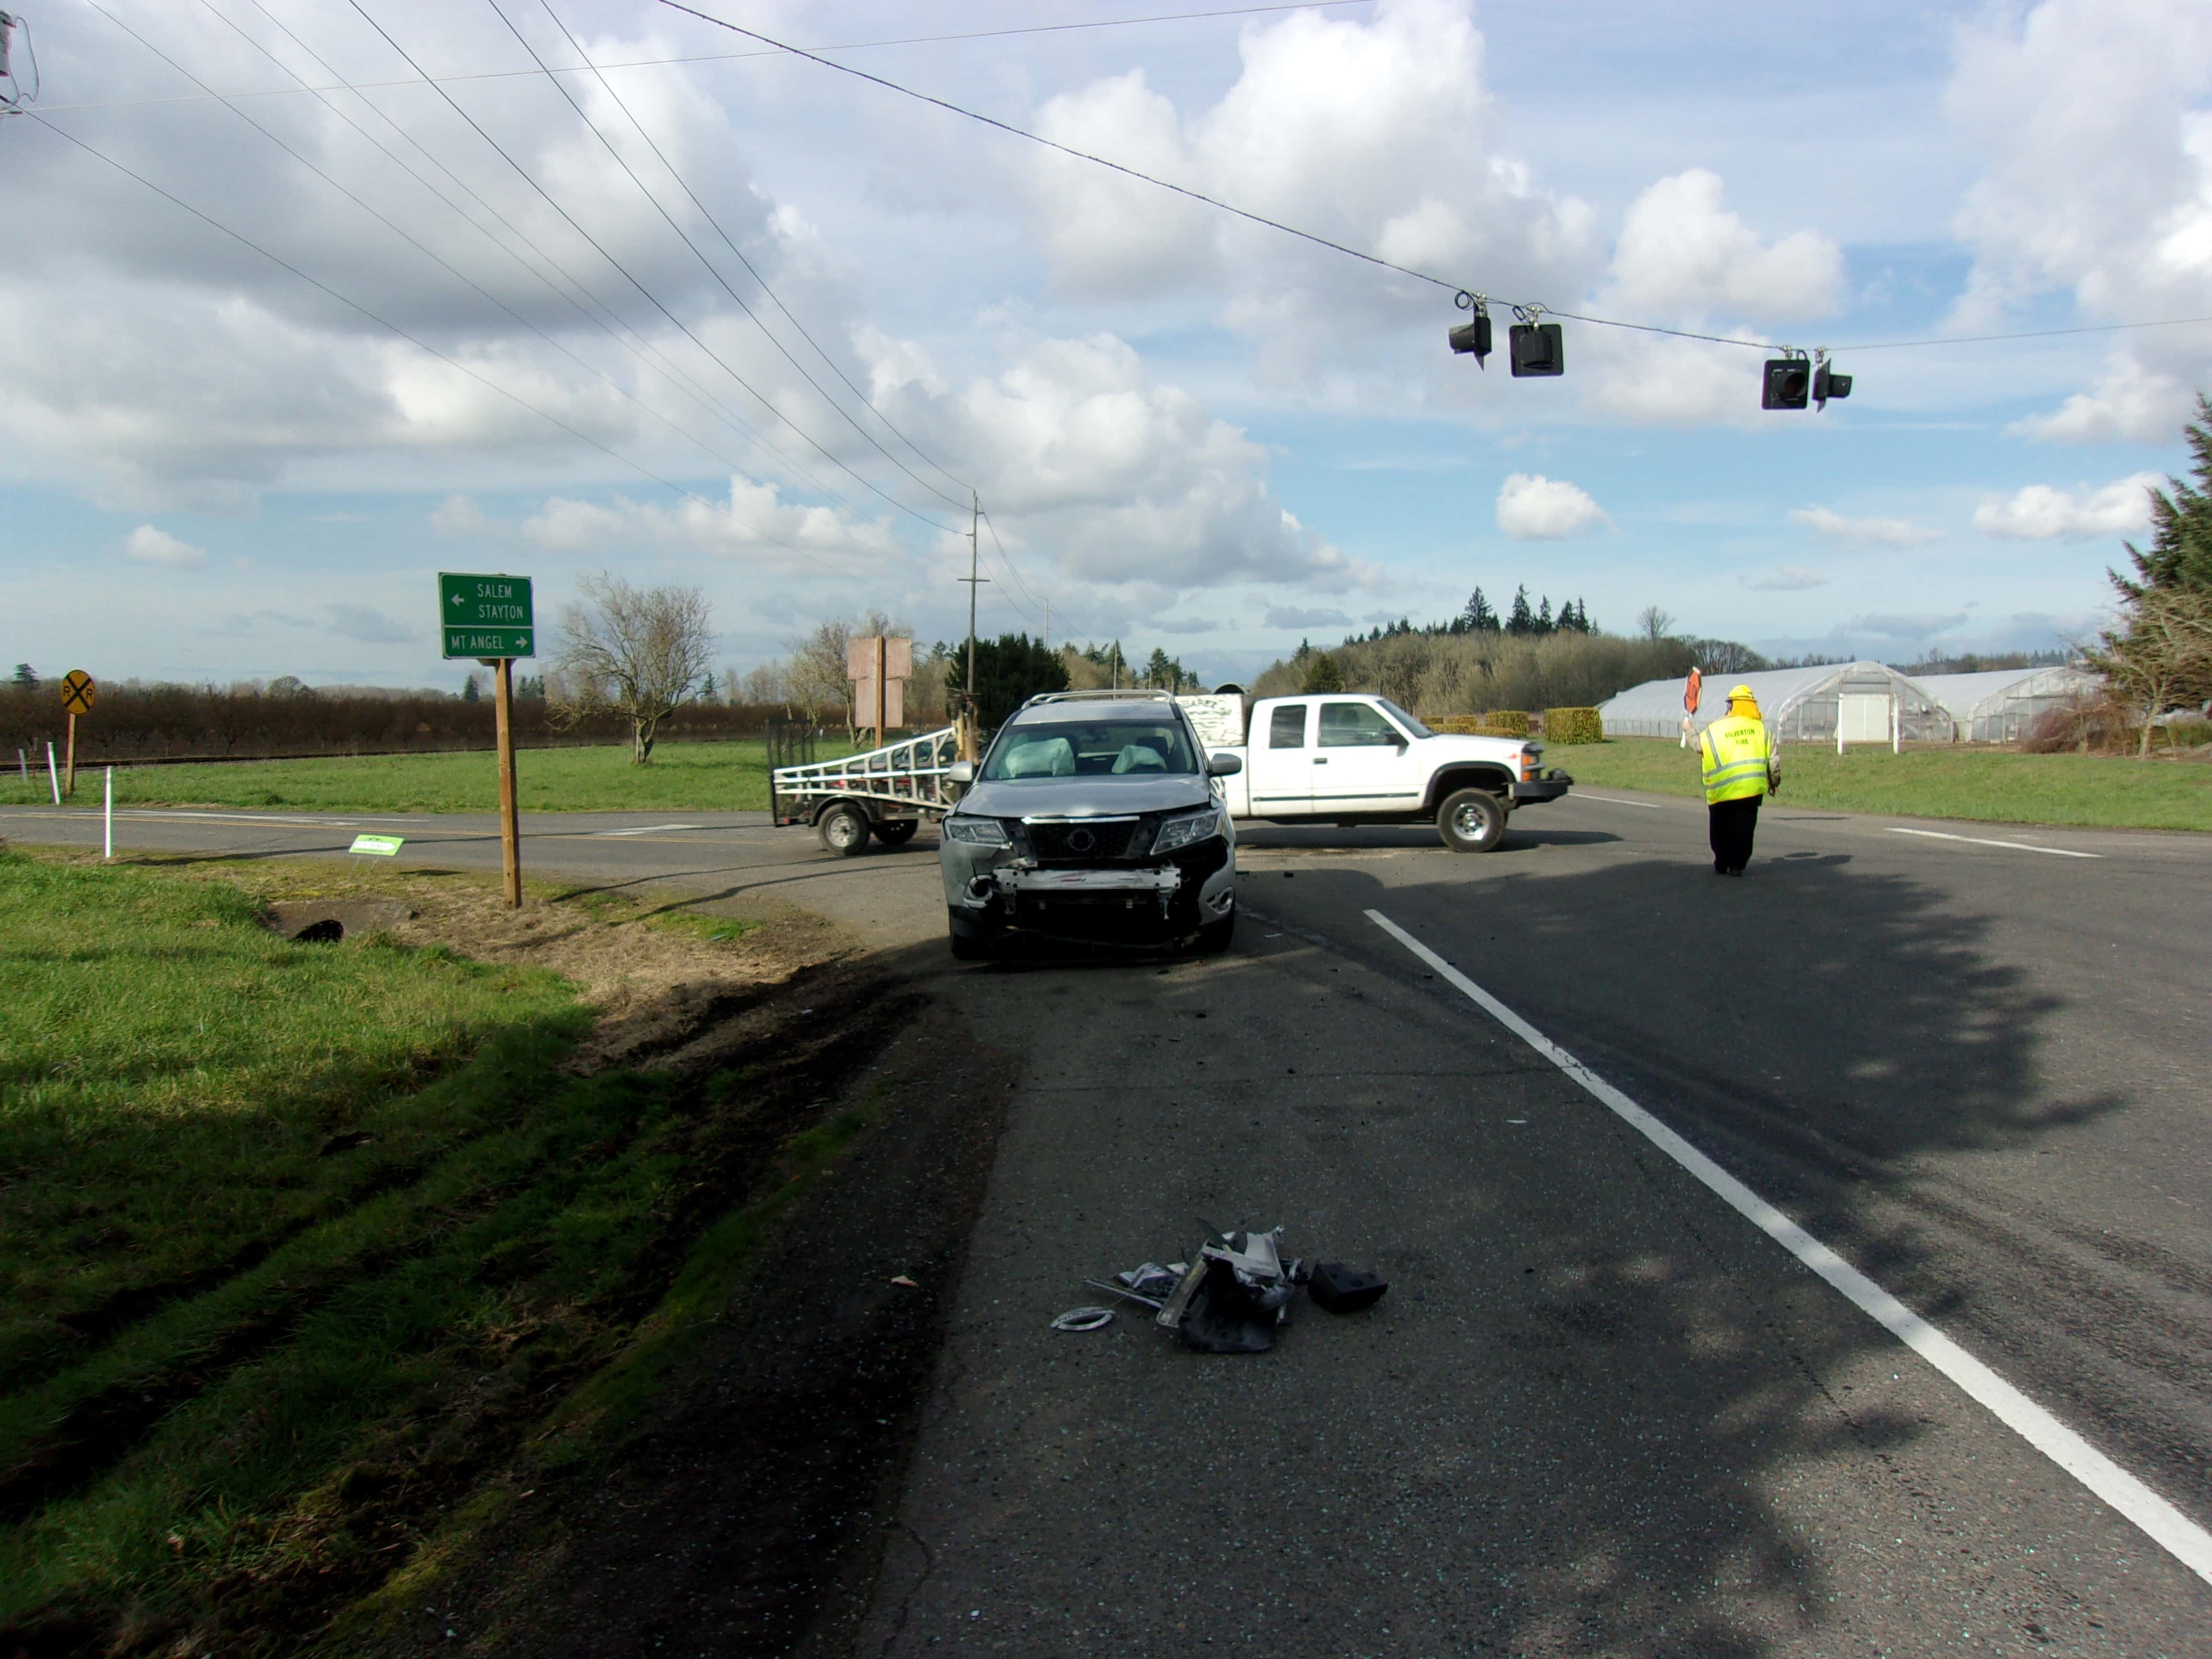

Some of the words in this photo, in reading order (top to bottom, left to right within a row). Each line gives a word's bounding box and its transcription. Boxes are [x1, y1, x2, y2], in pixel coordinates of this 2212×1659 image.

[477, 584, 512, 599] SALEM
[479, 605, 523, 619] STAYTON
[451, 635, 466, 649] MT
[470, 635, 505, 649] ANGEL
[63, 685, 70, 697] R
[86, 688, 93, 699] R
[1725, 728, 1755, 739] SILVERTON
